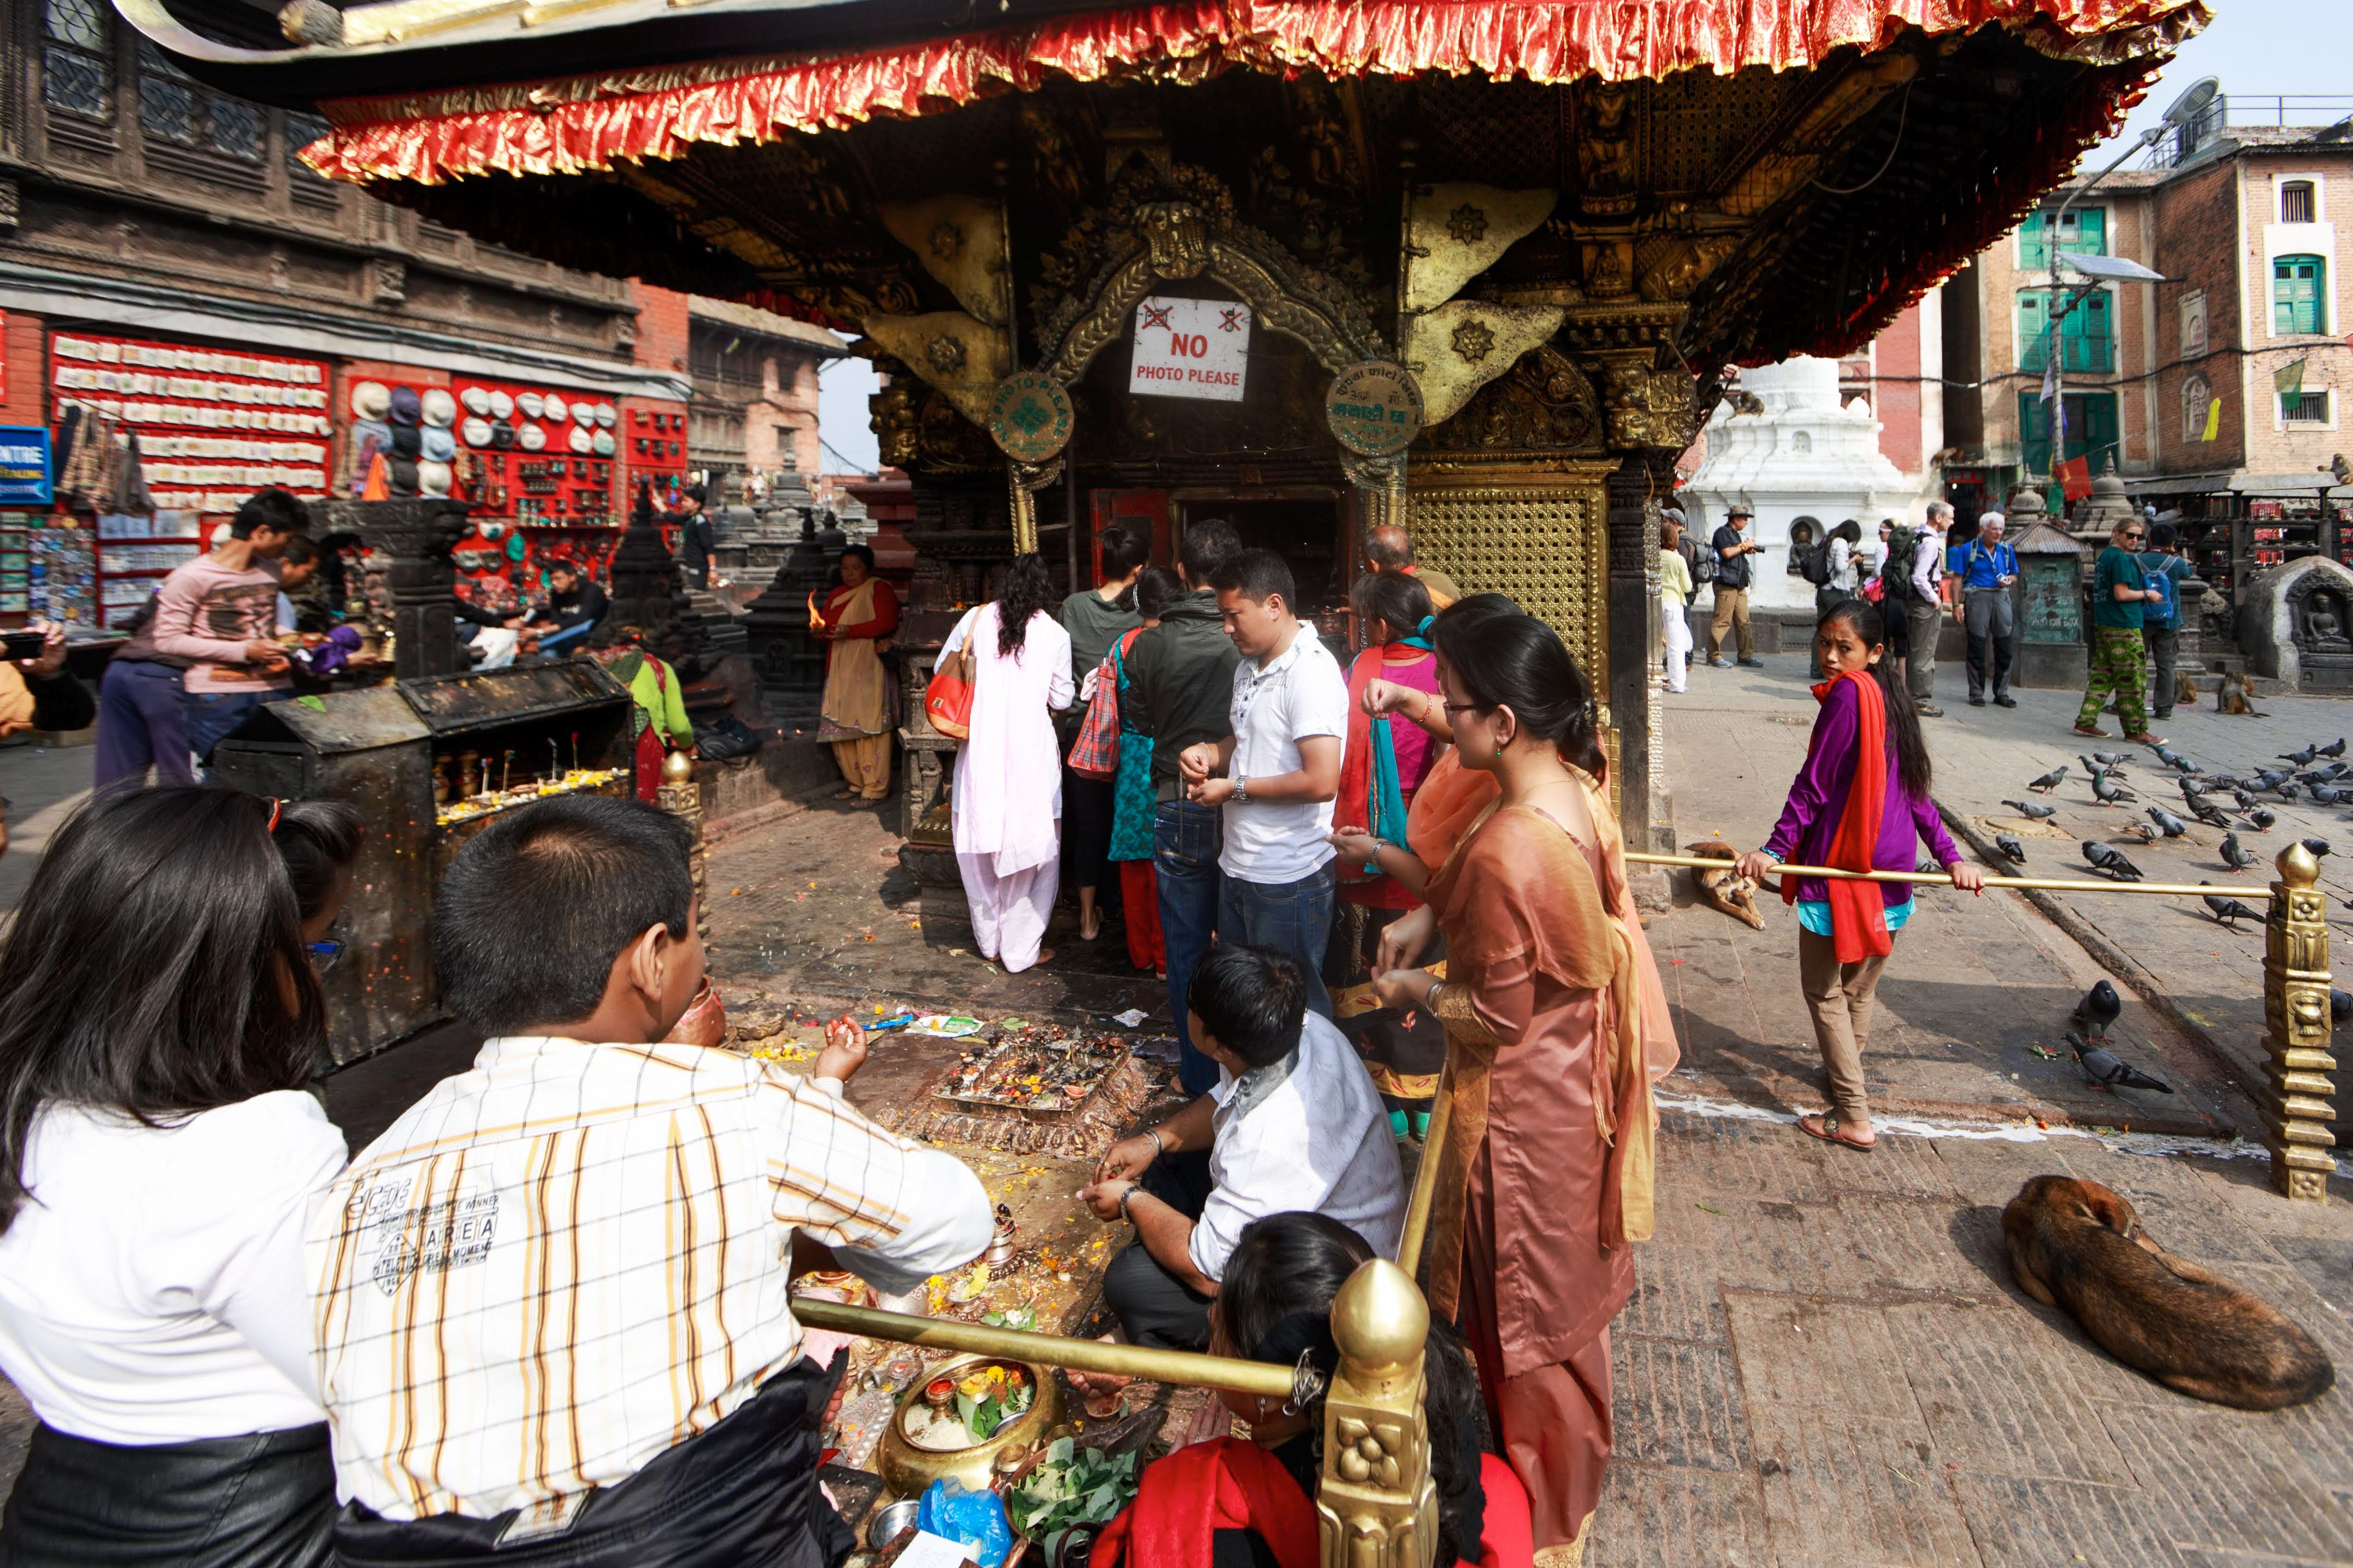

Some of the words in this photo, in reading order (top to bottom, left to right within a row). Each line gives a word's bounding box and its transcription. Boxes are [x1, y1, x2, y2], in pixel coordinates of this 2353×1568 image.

[1170, 333, 1207, 358] NO
[1137, 365, 1183, 381] PHOTO
[1188, 369, 1240, 386] PLEASE
[993, 376, 1034, 415] PHOTO
[1039, 380, 1069, 439] PLEASE
[993, 420, 1010, 442] NO
[466, 1195, 499, 1210] WINNER
[426, 1218, 493, 1247] AREA
